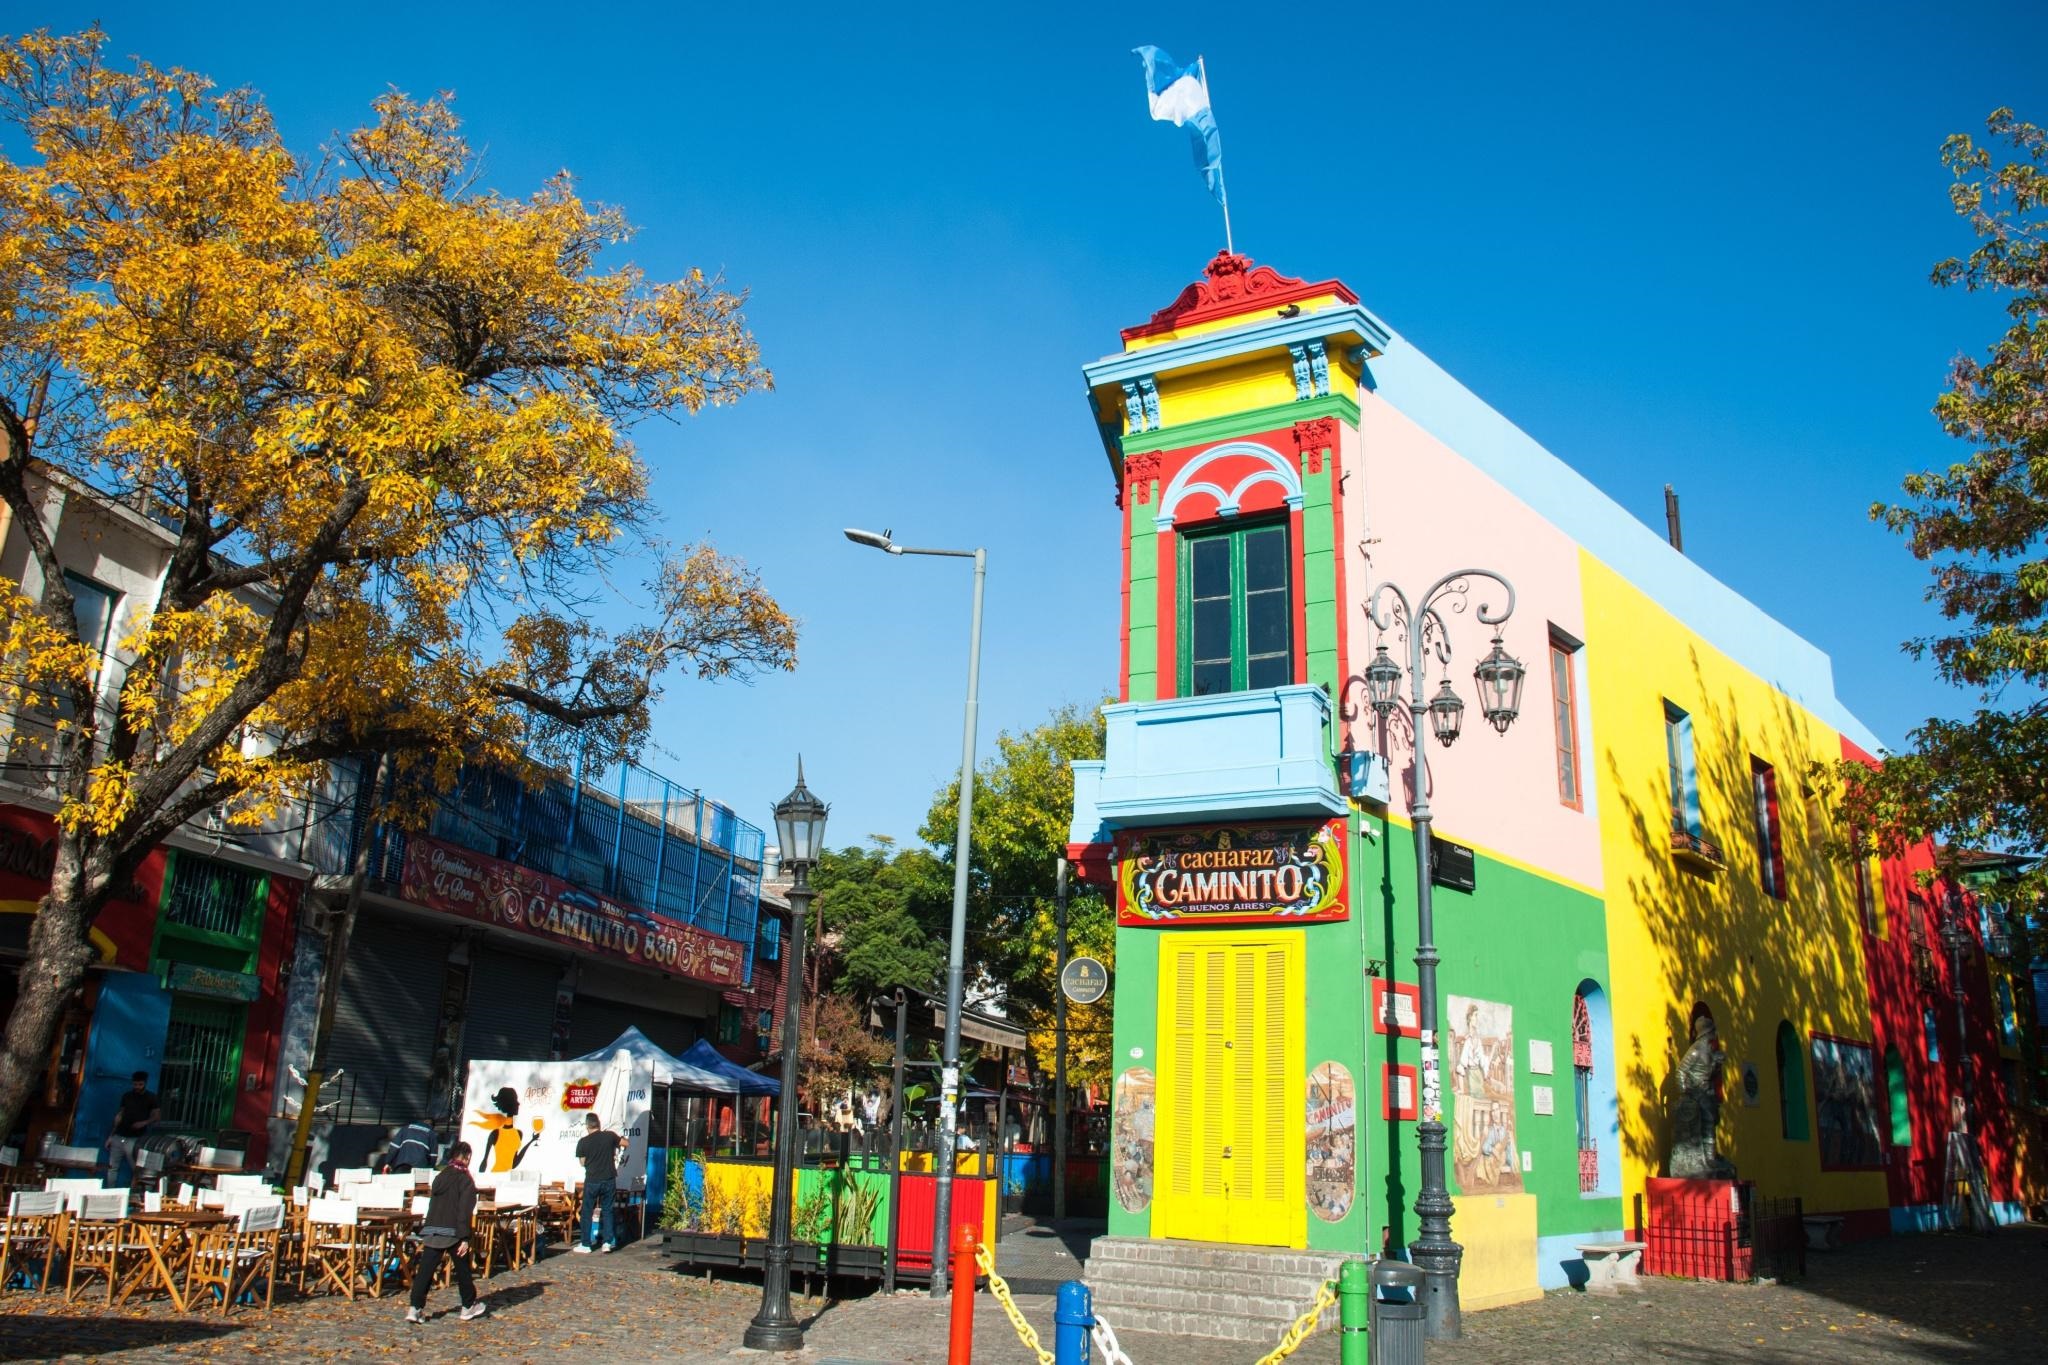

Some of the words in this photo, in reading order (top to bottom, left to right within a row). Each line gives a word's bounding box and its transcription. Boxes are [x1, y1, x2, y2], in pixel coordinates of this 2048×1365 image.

[1155, 864, 1303, 907] CAMINITO
[1188, 903, 1230, 912] BUENOS
[1233, 902, 1265, 911] AIRES
[528, 895, 639, 955] CAMINITO
[643, 930, 678, 966] 830
[570, 1096, 595, 1104] ARTOIS
